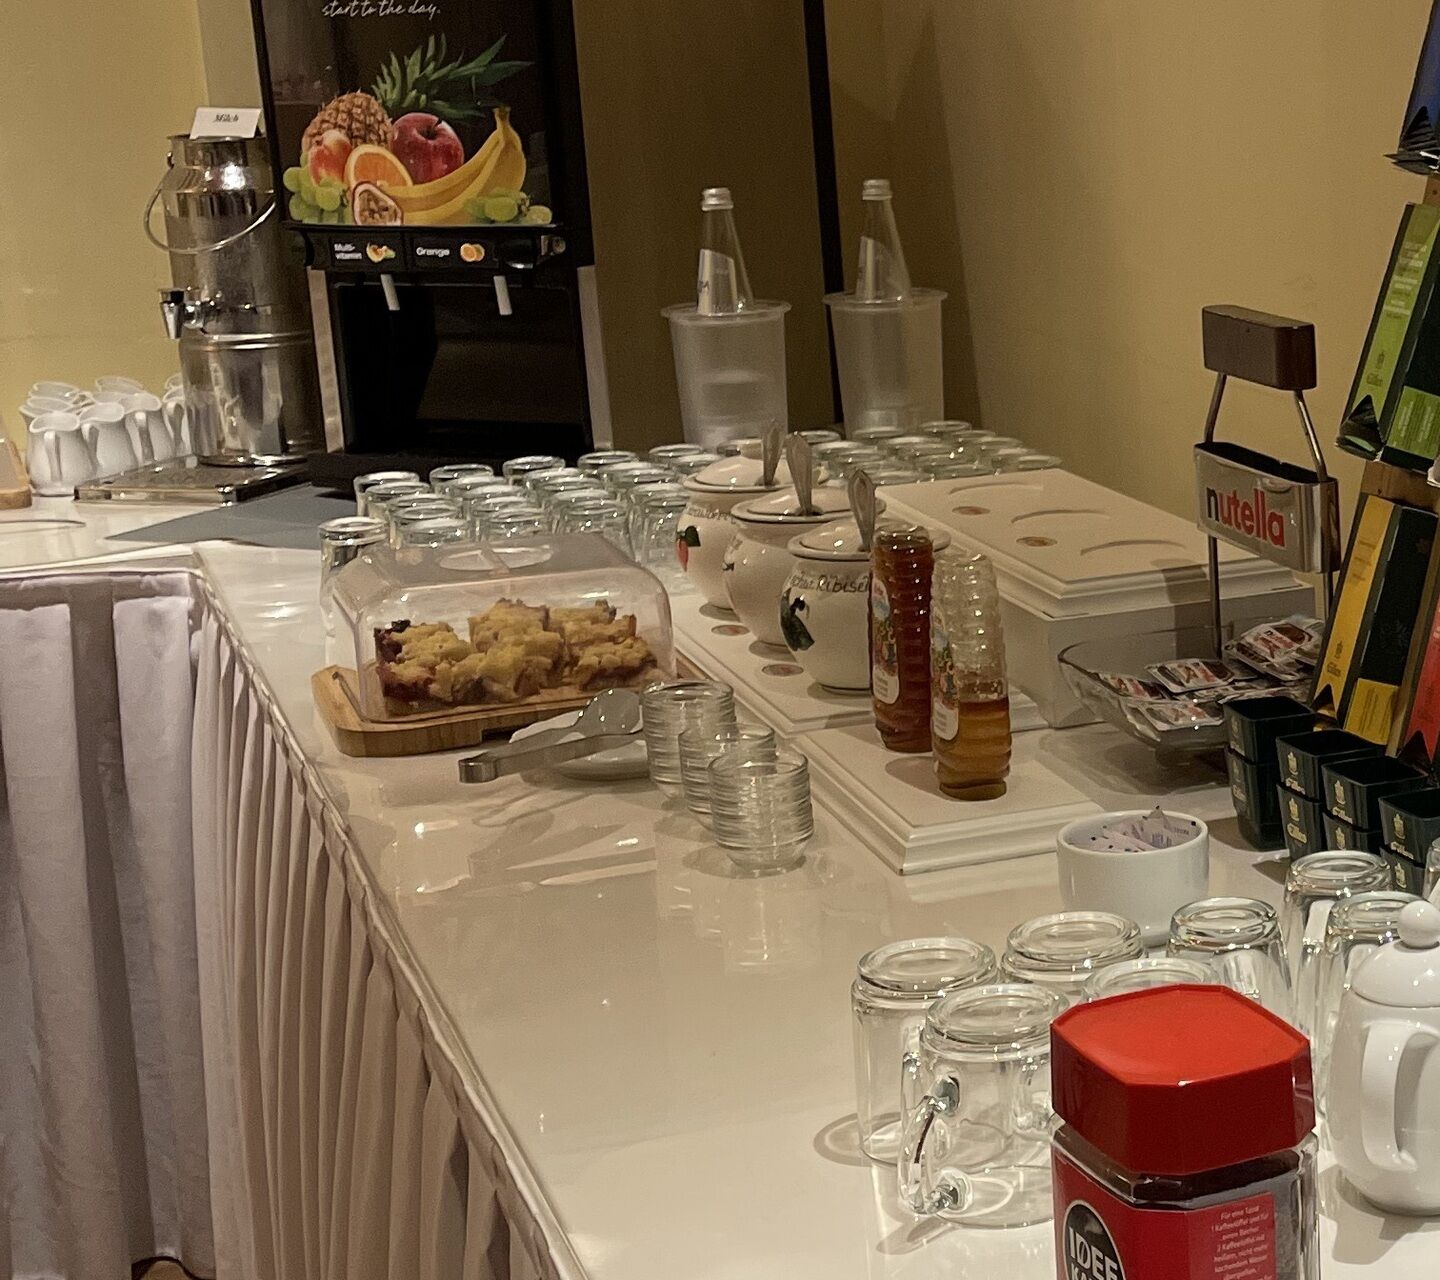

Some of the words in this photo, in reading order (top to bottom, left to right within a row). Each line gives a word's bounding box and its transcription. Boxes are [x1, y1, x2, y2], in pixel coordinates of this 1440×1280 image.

[322, 0, 360, 17] start
[361, 0, 377, 16] to
[408, 0, 441, 20] day.
[416, 247, 450, 258] Orange
[1206, 487, 1286, 548] nutella
